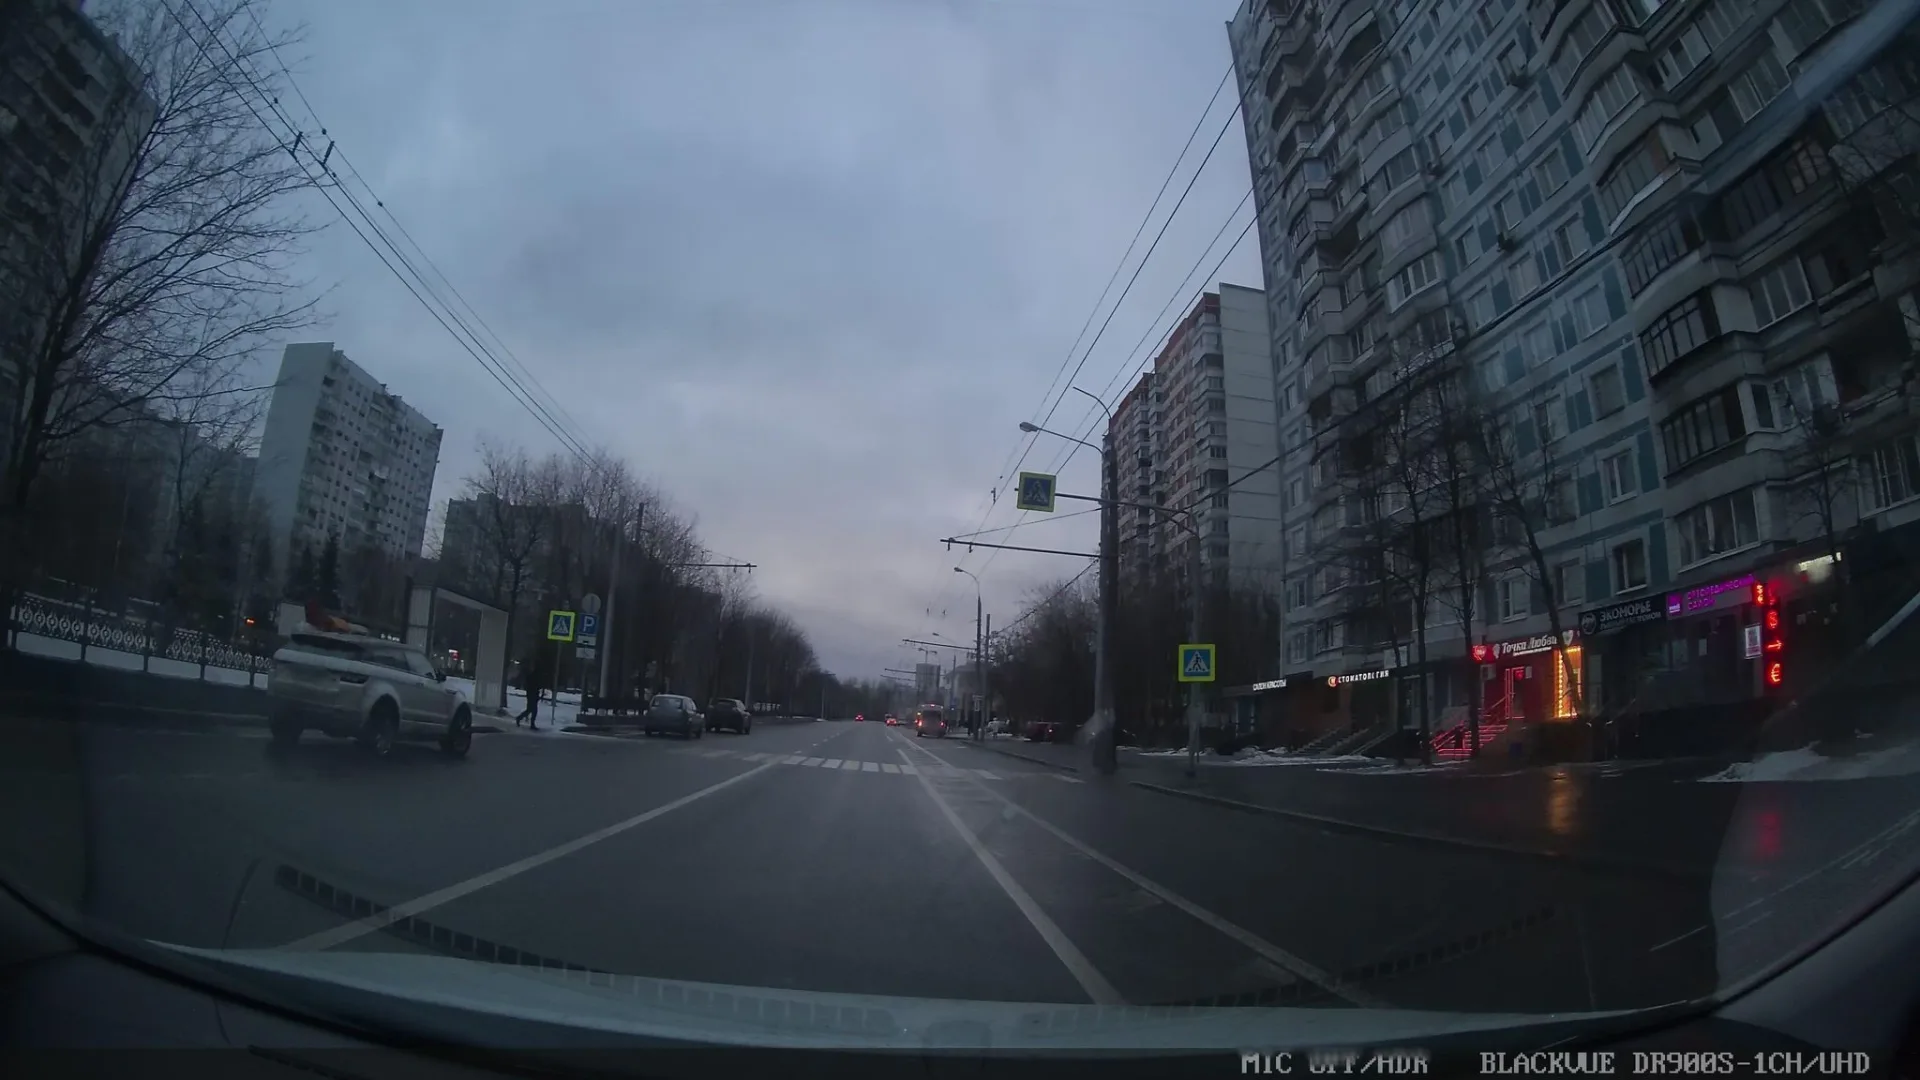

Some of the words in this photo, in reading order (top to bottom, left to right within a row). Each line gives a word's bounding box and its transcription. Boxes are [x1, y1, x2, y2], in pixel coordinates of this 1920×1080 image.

[1600, 600, 1652, 622] ЭКОМОРЬЕ
[583, 615, 595, 632] P
[1502, 642, 1527, 655] Точка
[1528, 634, 1557, 649] Любви
